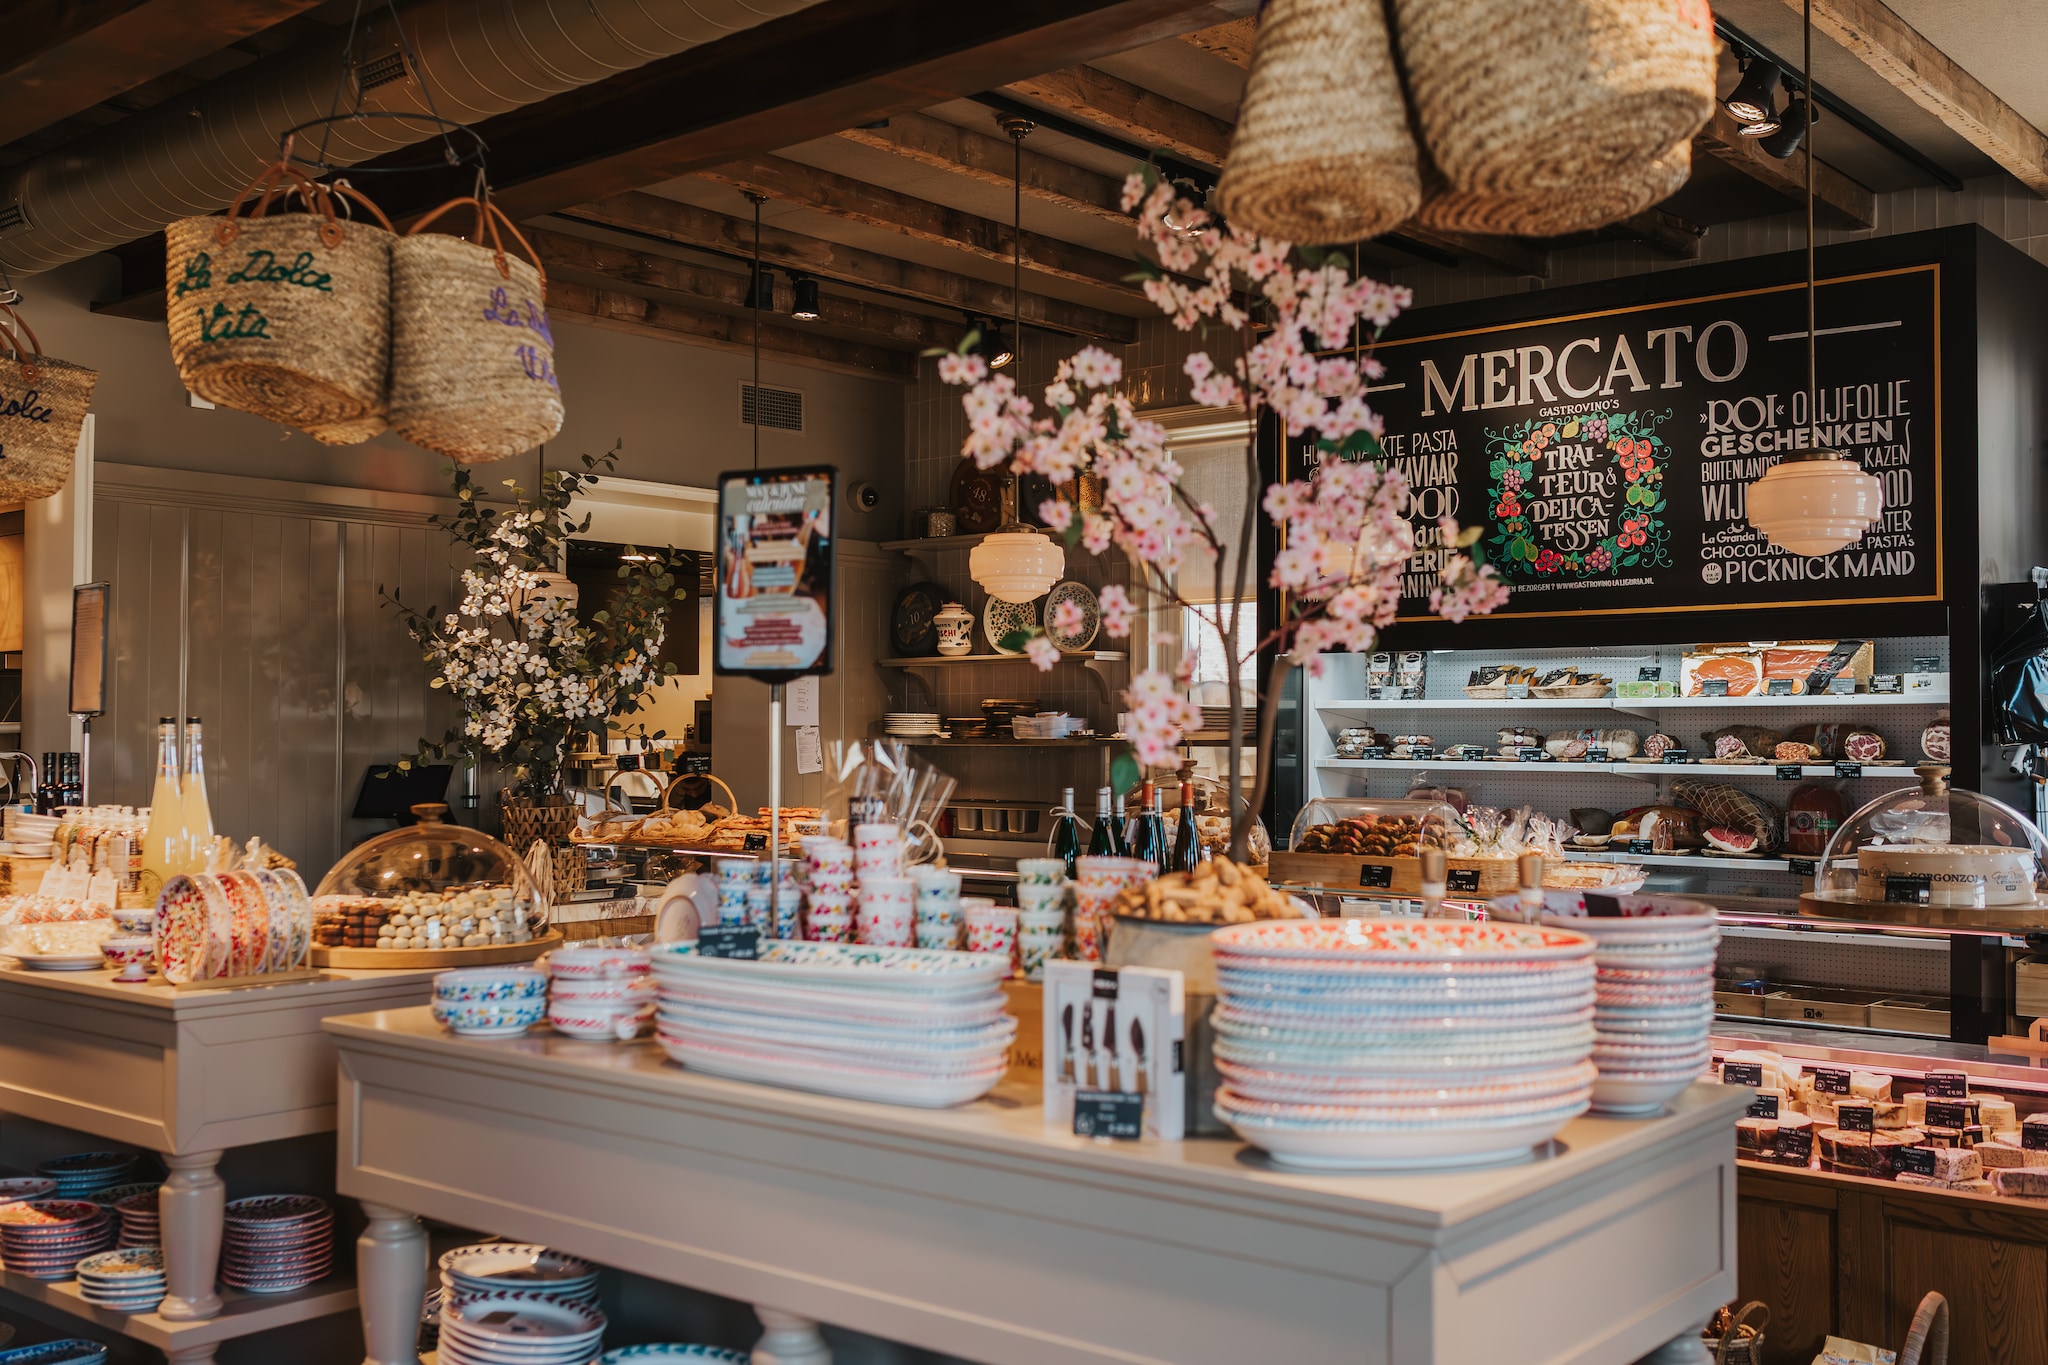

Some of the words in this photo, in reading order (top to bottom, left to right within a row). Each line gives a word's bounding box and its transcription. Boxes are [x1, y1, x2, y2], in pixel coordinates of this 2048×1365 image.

[175, 251, 212, 297] La
[226, 250, 333, 292] Dolce
[196, 301, 271, 342] Vita
[1420, 320, 1749, 417] MERCATO
[0, 390, 53, 424] olce
[1539, 399, 1620, 418] GASTROVINO'S
[1412, 429, 1458, 454] PASTA
[1700, 420, 1893, 458] GESCHENKEN
[1864, 434, 1910, 468] KAZEN
[1395, 452, 1459, 488] KAVIAAR
[1539, 470, 1616, 499] TEUR
[1605, 466, 1617, 486] &
[1701, 481, 1750, 522] WIJ
[1540, 518, 1610, 551] TESSEN
[1702, 532, 1715, 545] La
[1716, 530, 1755, 544] Granda
[1866, 533, 1915, 549] PASTA's
[1725, 555, 1839, 584] PICKNICK
[1844, 550, 1915, 578] MAND
[1518, 583, 1551, 593] BEZORGEN
[1900, 1146, 1927, 1155] Roquefort
